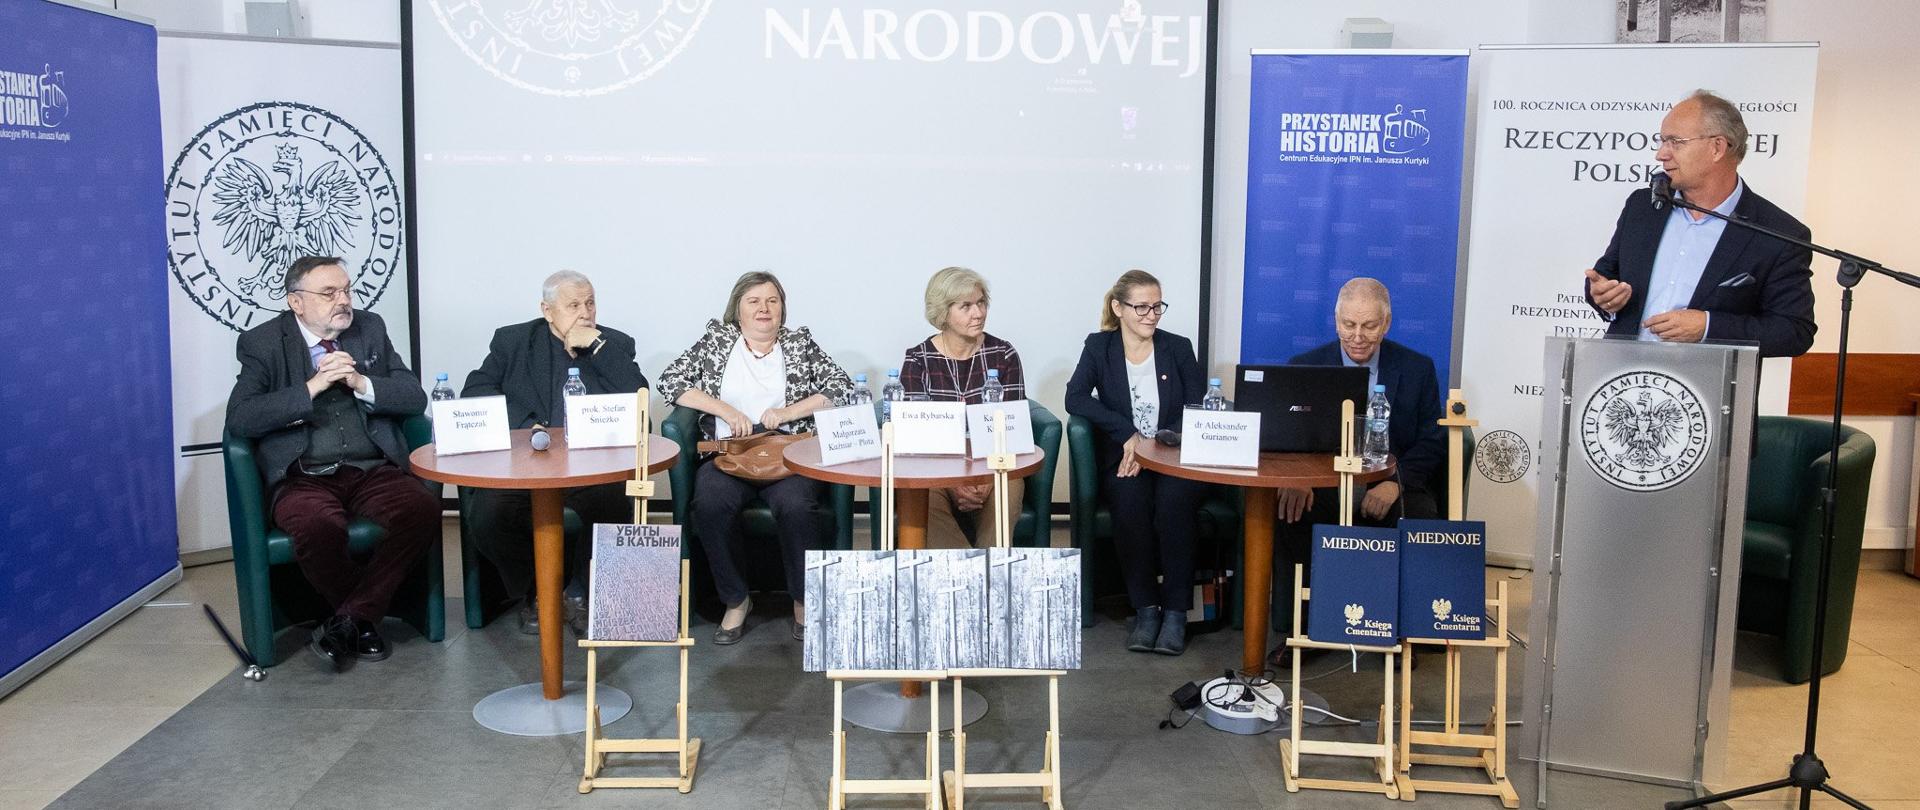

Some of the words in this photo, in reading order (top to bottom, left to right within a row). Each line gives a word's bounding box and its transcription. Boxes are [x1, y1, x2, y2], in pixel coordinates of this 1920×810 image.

[764, 8, 1203, 78] NARODOWEJ
[0, 70, 39, 97] STANEK
[0, 95, 40, 126] TORIA
[1493, 100, 1516, 110] 100.
[1520, 101, 1586, 111] ROCZNICA
[1590, 101, 1673, 111] ODZYSKANIA
[1739, 100, 1797, 112] EGŁOŚCI
[1281, 113, 1382, 131] PRZYSTANEK
[1280, 131, 1380, 153] HISTORIA
[1279, 154, 1308, 162] Centrum
[1309, 155, 1347, 165] Edukacyjne
[1363, 156, 1373, 164] im.
[1404, 157, 1430, 166] Kurtyki
[172, 177, 253, 327] INSTYTUT
[348, 142, 395, 304] NARODOW
[1511, 304, 1597, 320] PREZYDENTA
[902, 411, 919, 419] Ewa
[1205, 421, 1248, 431] Aleksander
[1586, 406, 1622, 478] INSTYTUT
[1660, 390, 1704, 480] NARODOWEJ
[616, 525, 660, 537] УБИТЫ
[616, 537, 625, 547] В
[627, 537, 680, 548] КАТЫНИ
[1322, 537, 1395, 552] MIEDNOJE
[1407, 532, 1481, 545] MIEDNOJE
[1364, 619, 1393, 631] Księga
[1452, 614, 1480, 625] Księga
[1345, 626, 1393, 638] Cmentarna
[1433, 621, 1481, 632] Cmentarna
